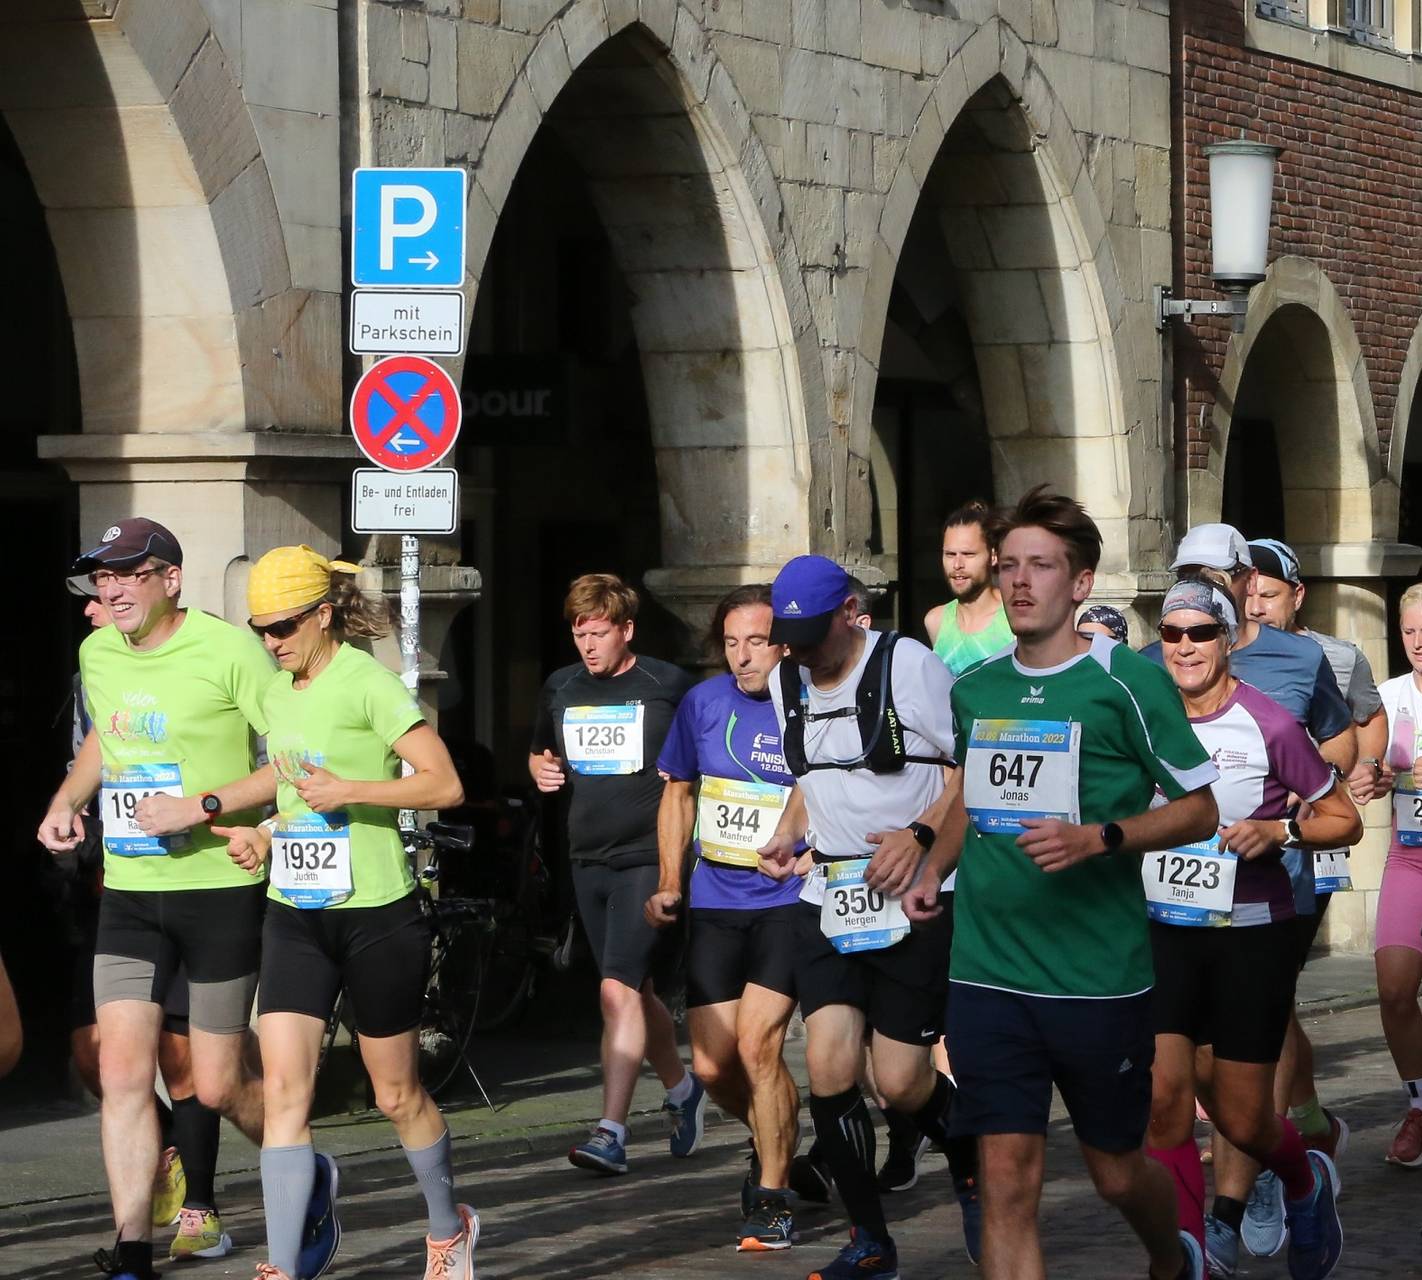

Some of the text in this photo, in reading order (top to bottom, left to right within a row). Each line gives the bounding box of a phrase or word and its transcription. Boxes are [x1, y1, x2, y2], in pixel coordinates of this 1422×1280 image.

[380, 184, 438, 271] P
[393, 306, 420, 320] mit
[361, 325, 453, 341] Parkschein
[362, 485, 448, 498] Be- und Entladen
[393, 504, 416, 517] frei
[1021, 696, 1045, 704] erima
[575, 726, 626, 747] 1236
[886, 708, 901, 755] NATHAN
[999, 732, 1040, 743] Marathon
[1042, 733, 1065, 744] 2023
[585, 747, 615, 755] Christian
[751, 751, 785, 765] FINIS
[989, 753, 1044, 788] 647
[1000, 788, 1029, 801] Jonas
[112, 791, 166, 820] 19
[716, 804, 760, 833] 344
[287, 824, 323, 832] Marathon
[720, 830, 753, 843] Manfred
[282, 842, 337, 870] 1932
[294, 871, 318, 881] Judith
[836, 871, 864, 880] Marat
[1157, 854, 1221, 890] 1223
[1171, 886, 1194, 900] Tanja
[834, 887, 884, 916] 350
[845, 916, 877, 926] Hergen
